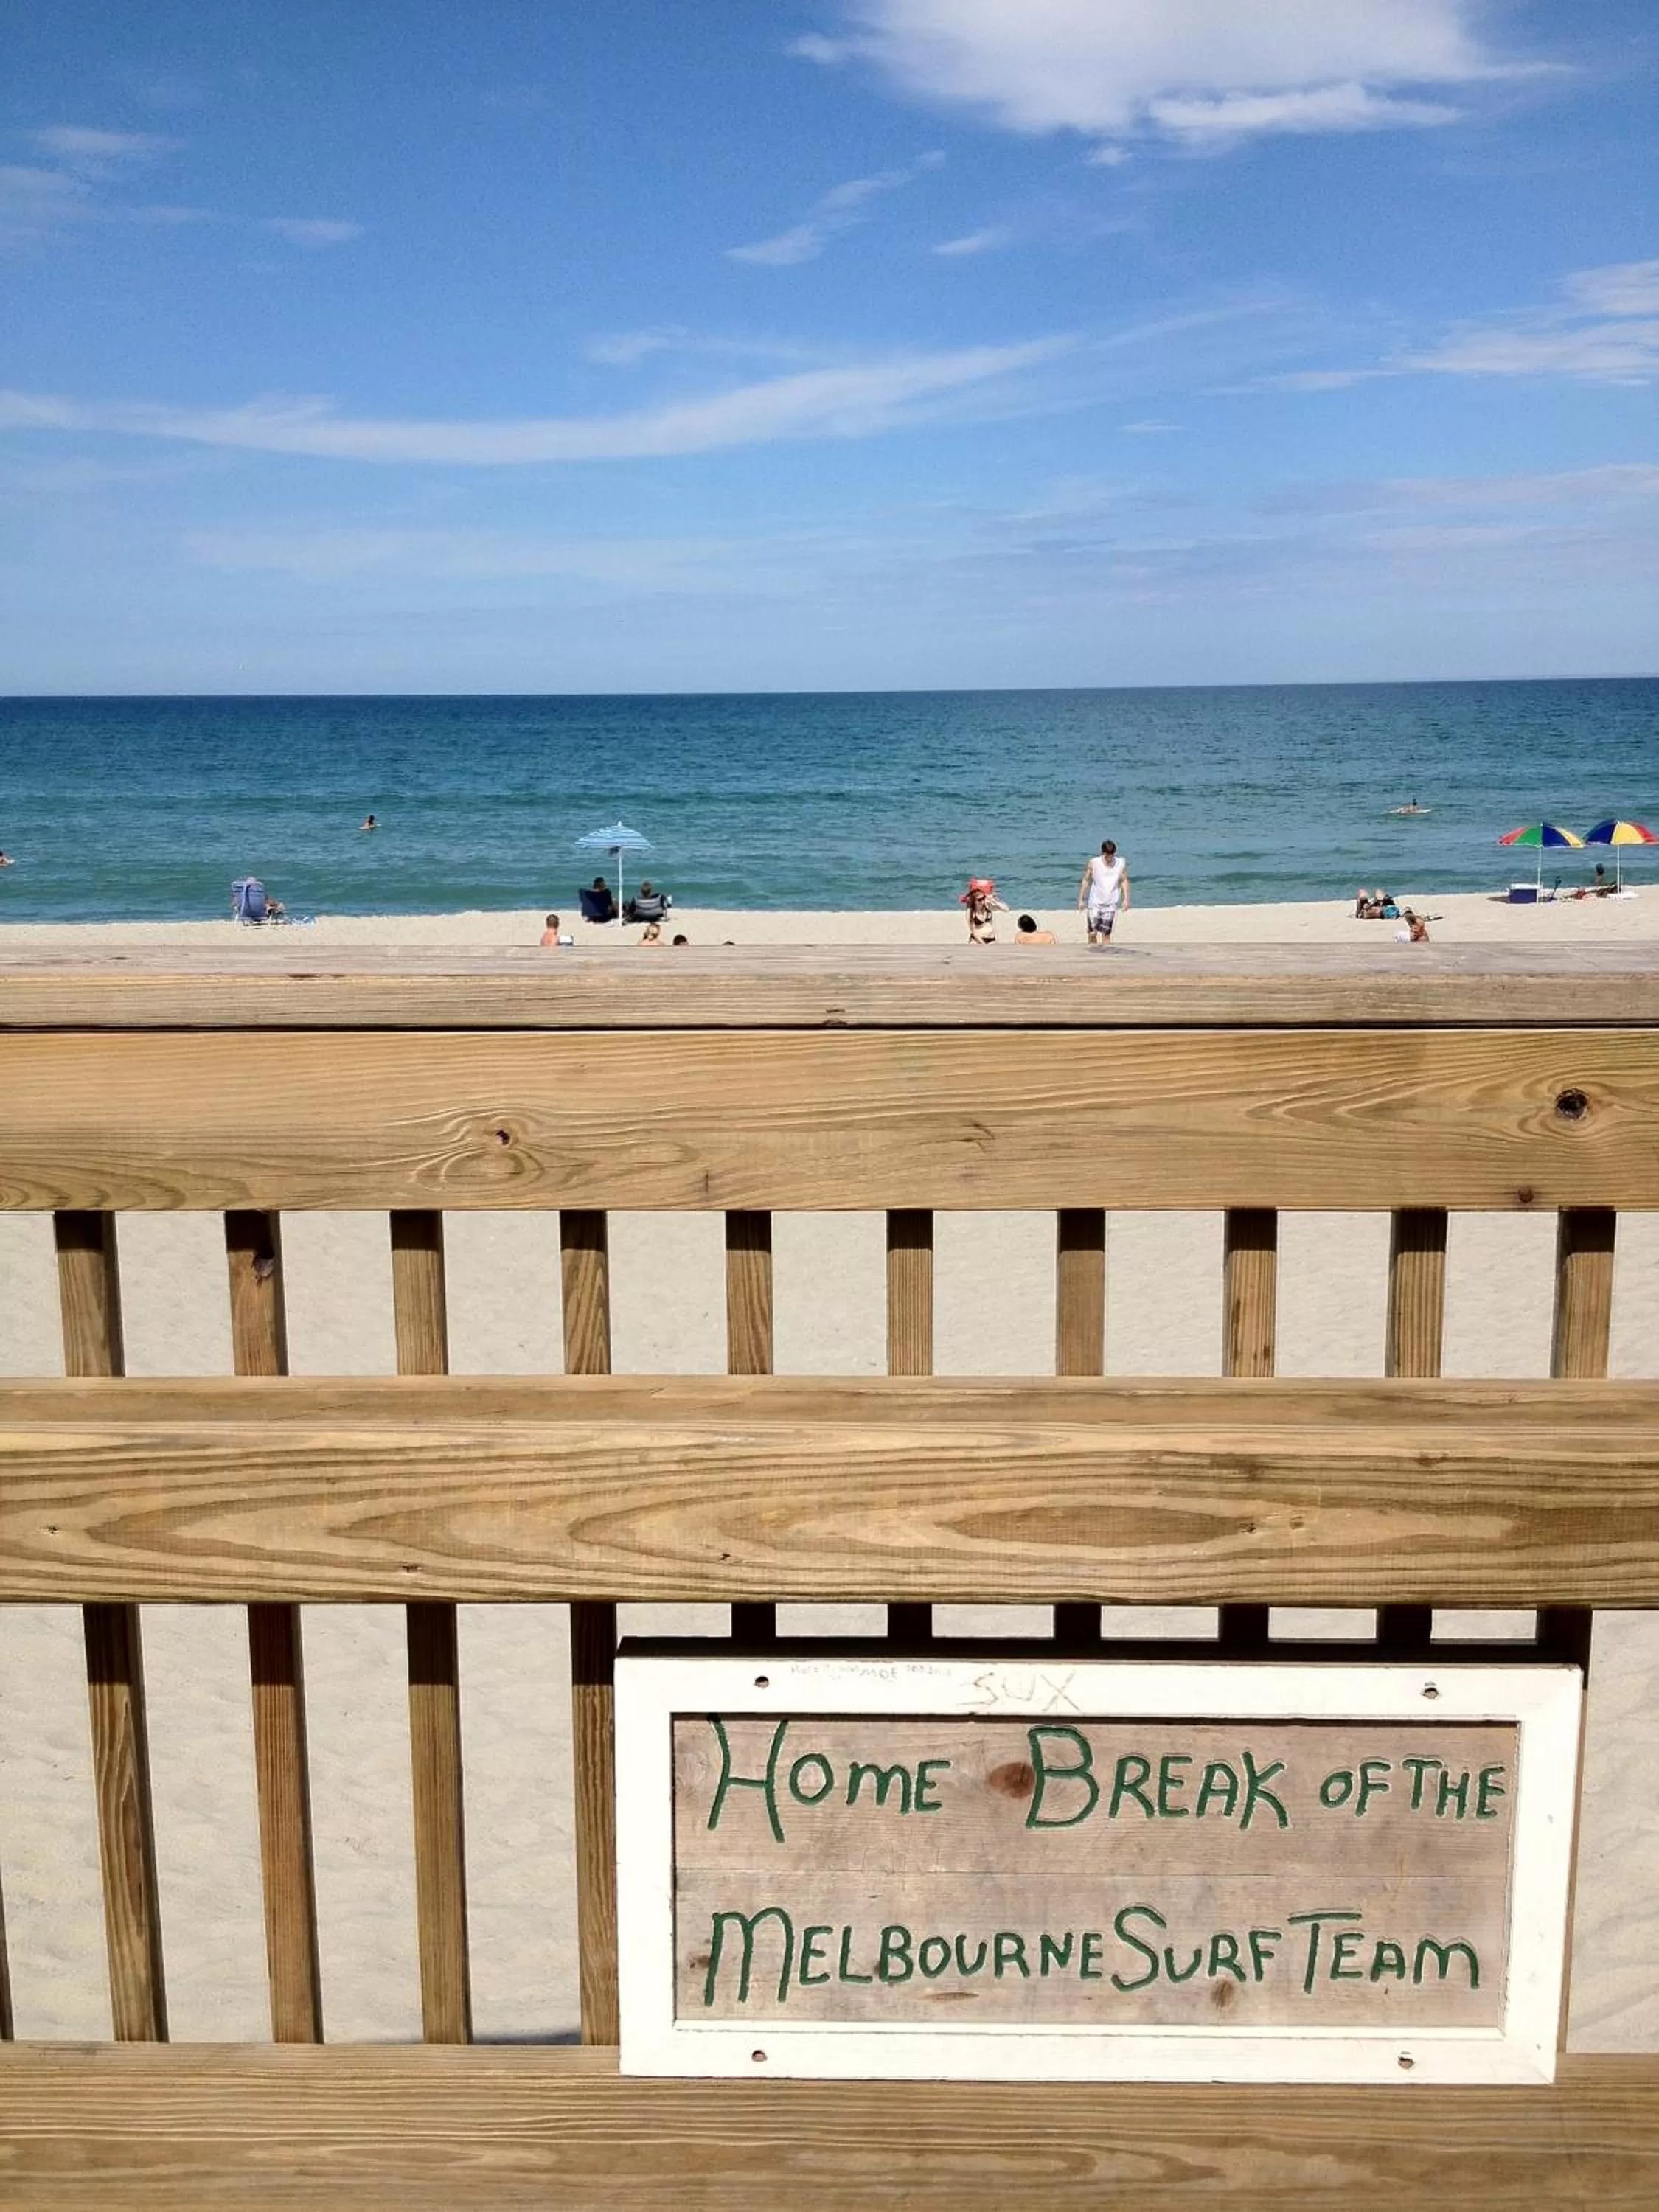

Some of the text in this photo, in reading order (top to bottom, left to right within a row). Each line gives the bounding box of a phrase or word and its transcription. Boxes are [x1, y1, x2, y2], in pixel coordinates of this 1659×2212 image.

[1026, 1725, 1290, 1829] BREAK
[1403, 1757, 1506, 1819] THE
[705, 1906, 1479, 2006] MELBOURNE SURF TEAM
